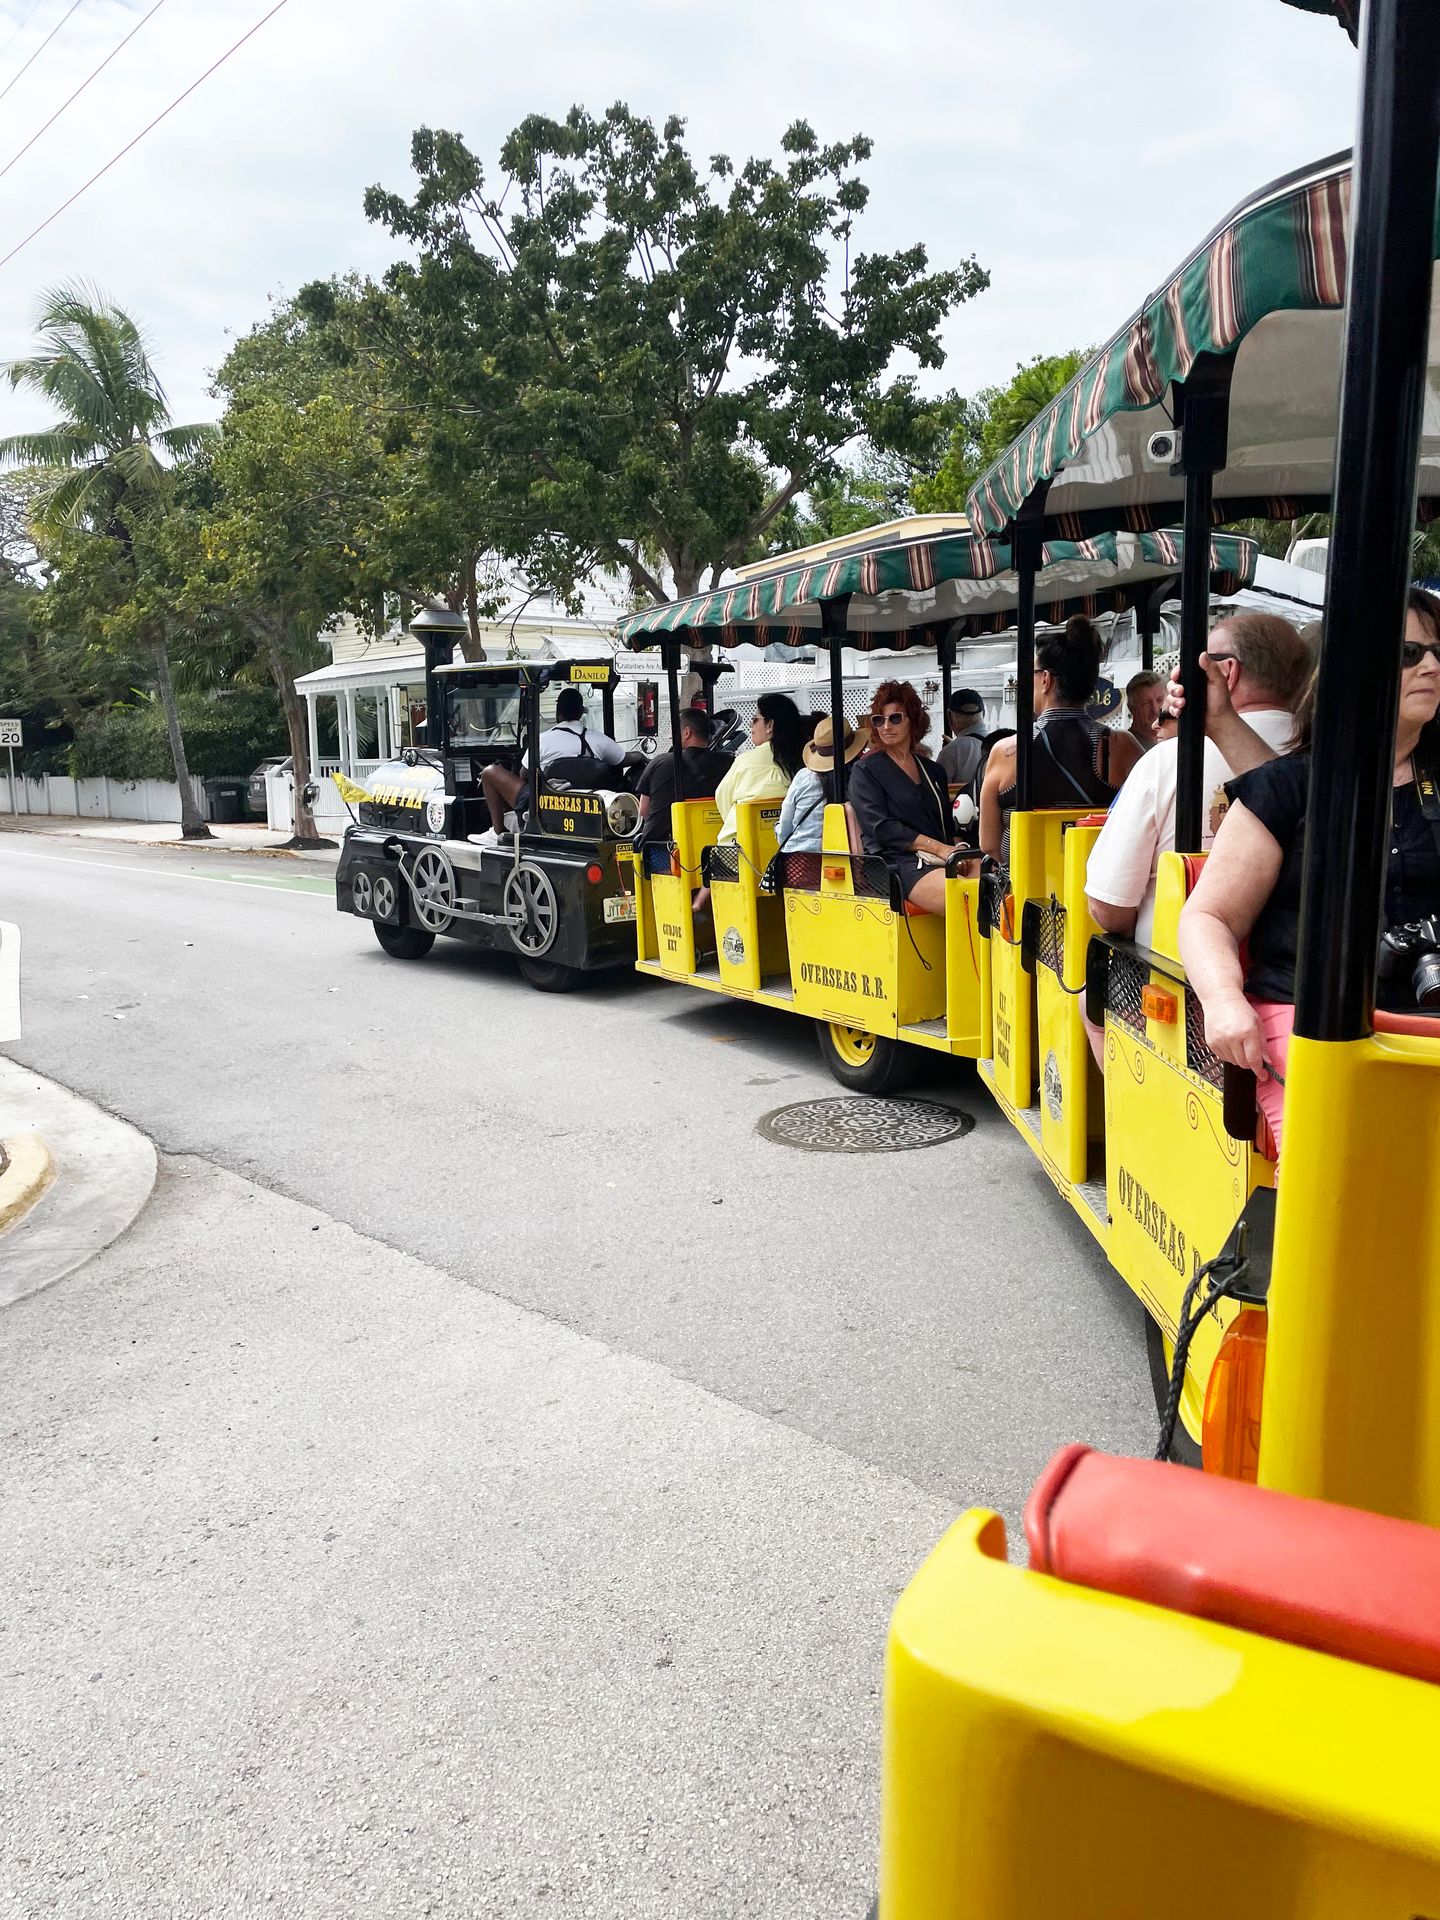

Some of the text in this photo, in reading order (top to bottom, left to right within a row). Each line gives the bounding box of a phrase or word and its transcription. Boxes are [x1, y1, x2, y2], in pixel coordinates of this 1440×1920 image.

[574, 669, 606, 680] DANILO
[1, 733, 20, 743] 20
[399, 787, 427, 810] TRA
[539, 794, 602, 815] OVERSEAS R.R.
[762, 809, 781, 817] CAUT
[563, 818, 575, 832] 99
[801, 962, 888, 1000] OVERSEAS R.R.
[1119, 1166, 1186, 1276] OVERSEAS
